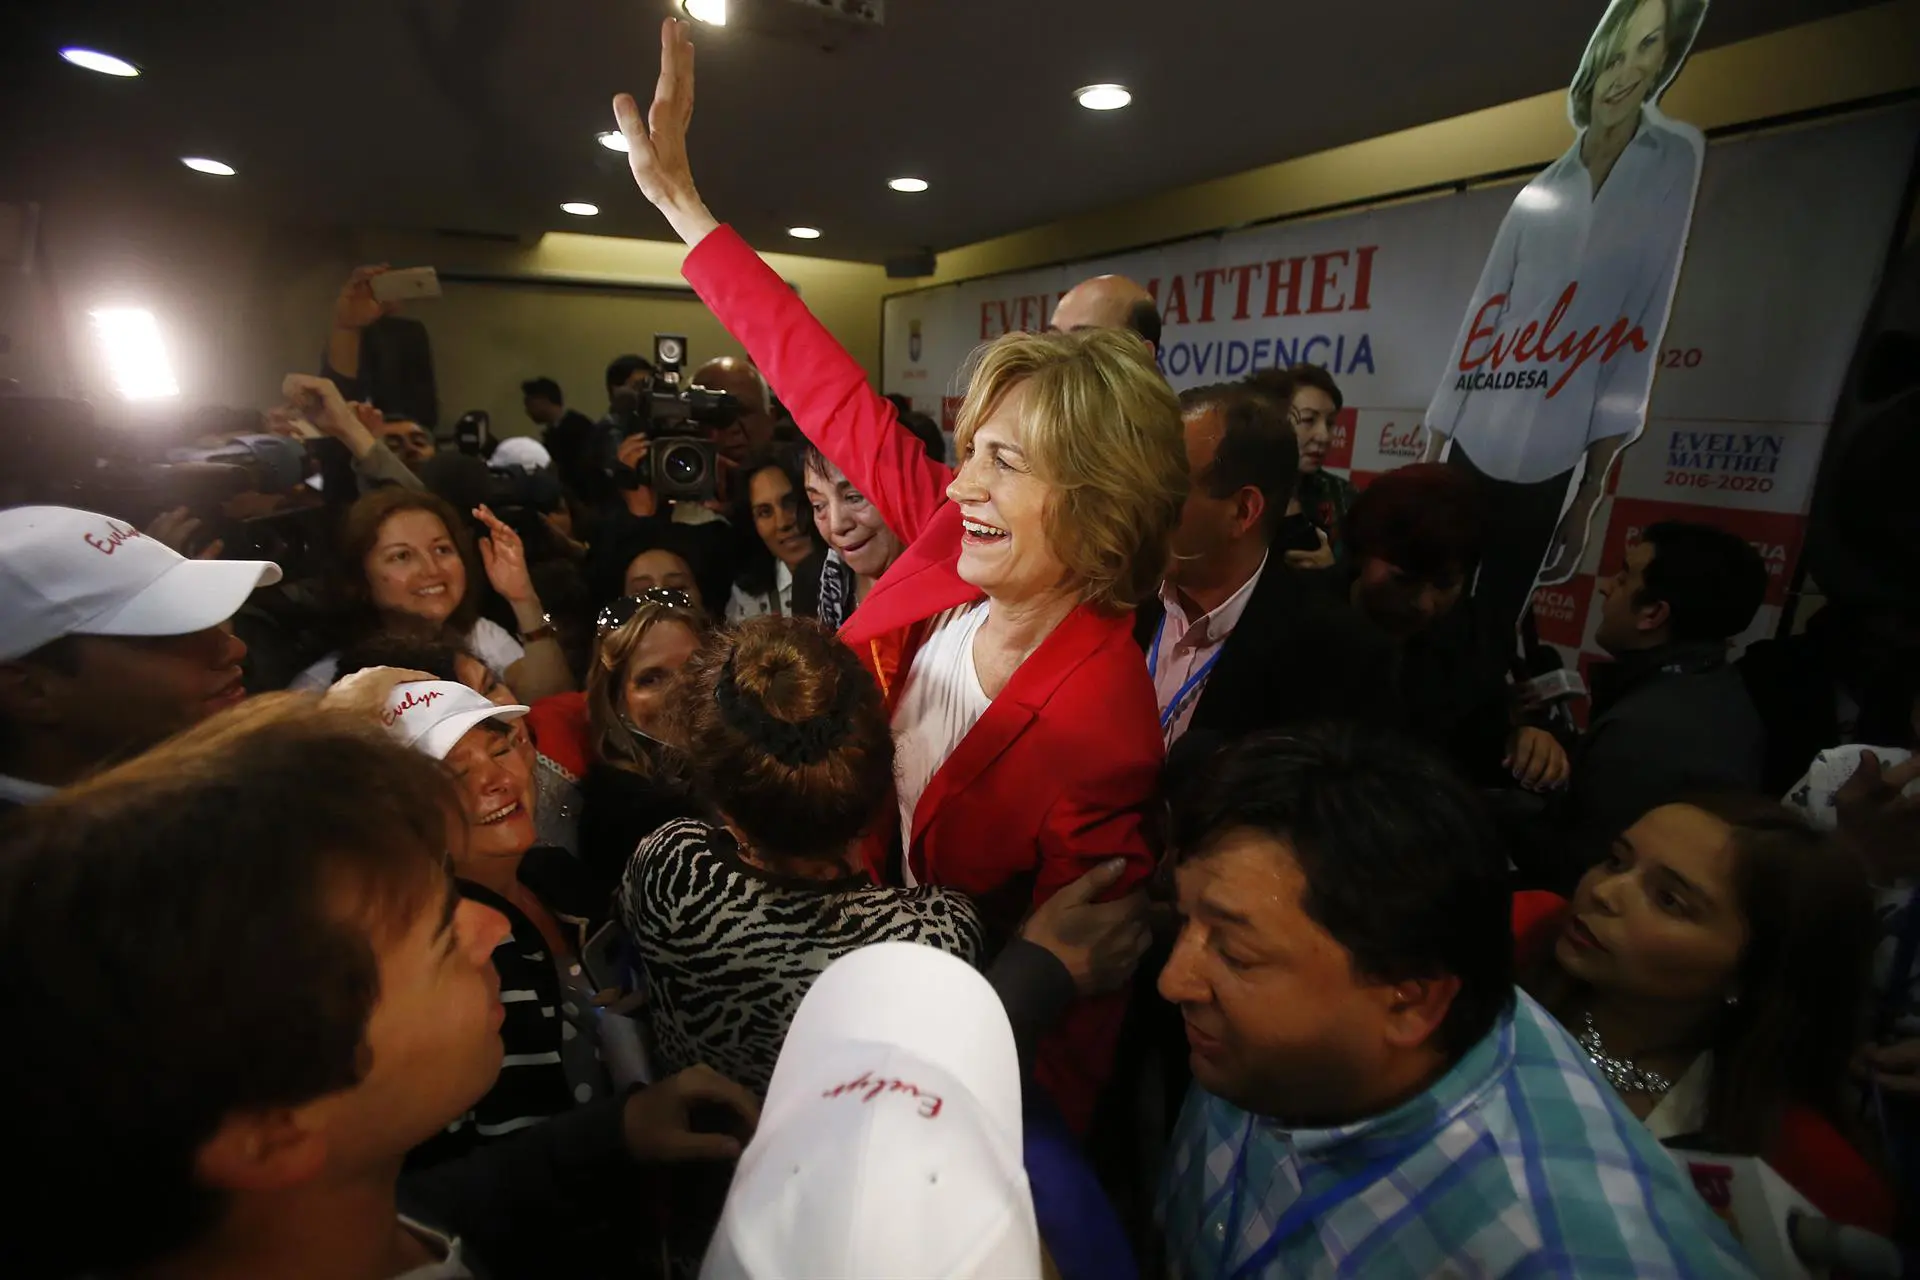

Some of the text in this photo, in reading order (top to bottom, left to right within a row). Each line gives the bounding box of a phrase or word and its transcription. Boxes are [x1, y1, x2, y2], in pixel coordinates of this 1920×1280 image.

[1156, 333, 1376, 377] ROVIDENCIA
[1458, 281, 1649, 399] Evelyn
[1454, 369, 1549, 391] ALCALDESA
[1669, 431, 1785, 456] EVELYN
[1667, 452, 1780, 474] MATTHEI
[1664, 471, 1774, 494] 2016-2020
[379, 691, 445, 727] Evelyn
[822, 1070, 943, 1119] Evelyn
